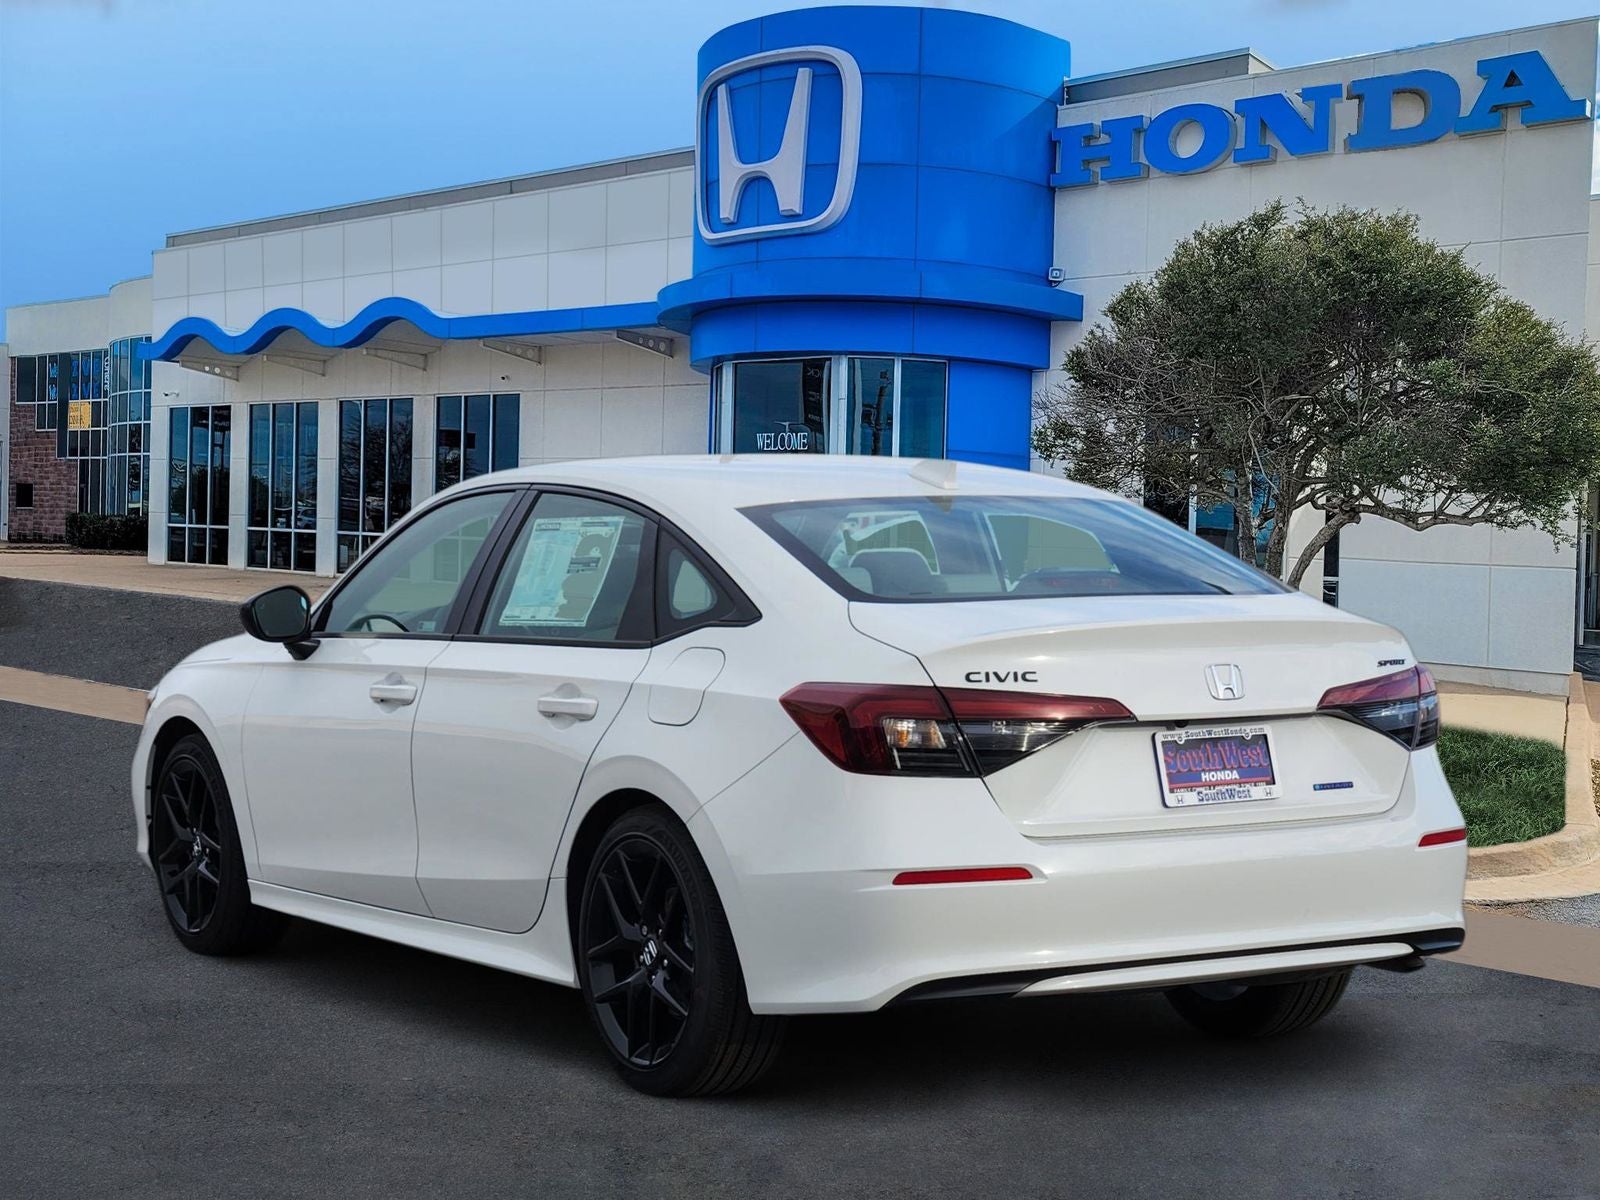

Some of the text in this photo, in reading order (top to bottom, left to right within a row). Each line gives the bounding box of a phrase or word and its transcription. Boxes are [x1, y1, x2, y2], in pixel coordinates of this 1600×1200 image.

[1049, 50, 1590, 188] HONDA
[756, 432, 809, 451] WELCOME
[964, 671, 1039, 684] CIVIC
[1163, 741, 1269, 773] SouthWest
[1201, 770, 1240, 782] HONDA
[1197, 788, 1253, 802] SouthWest
